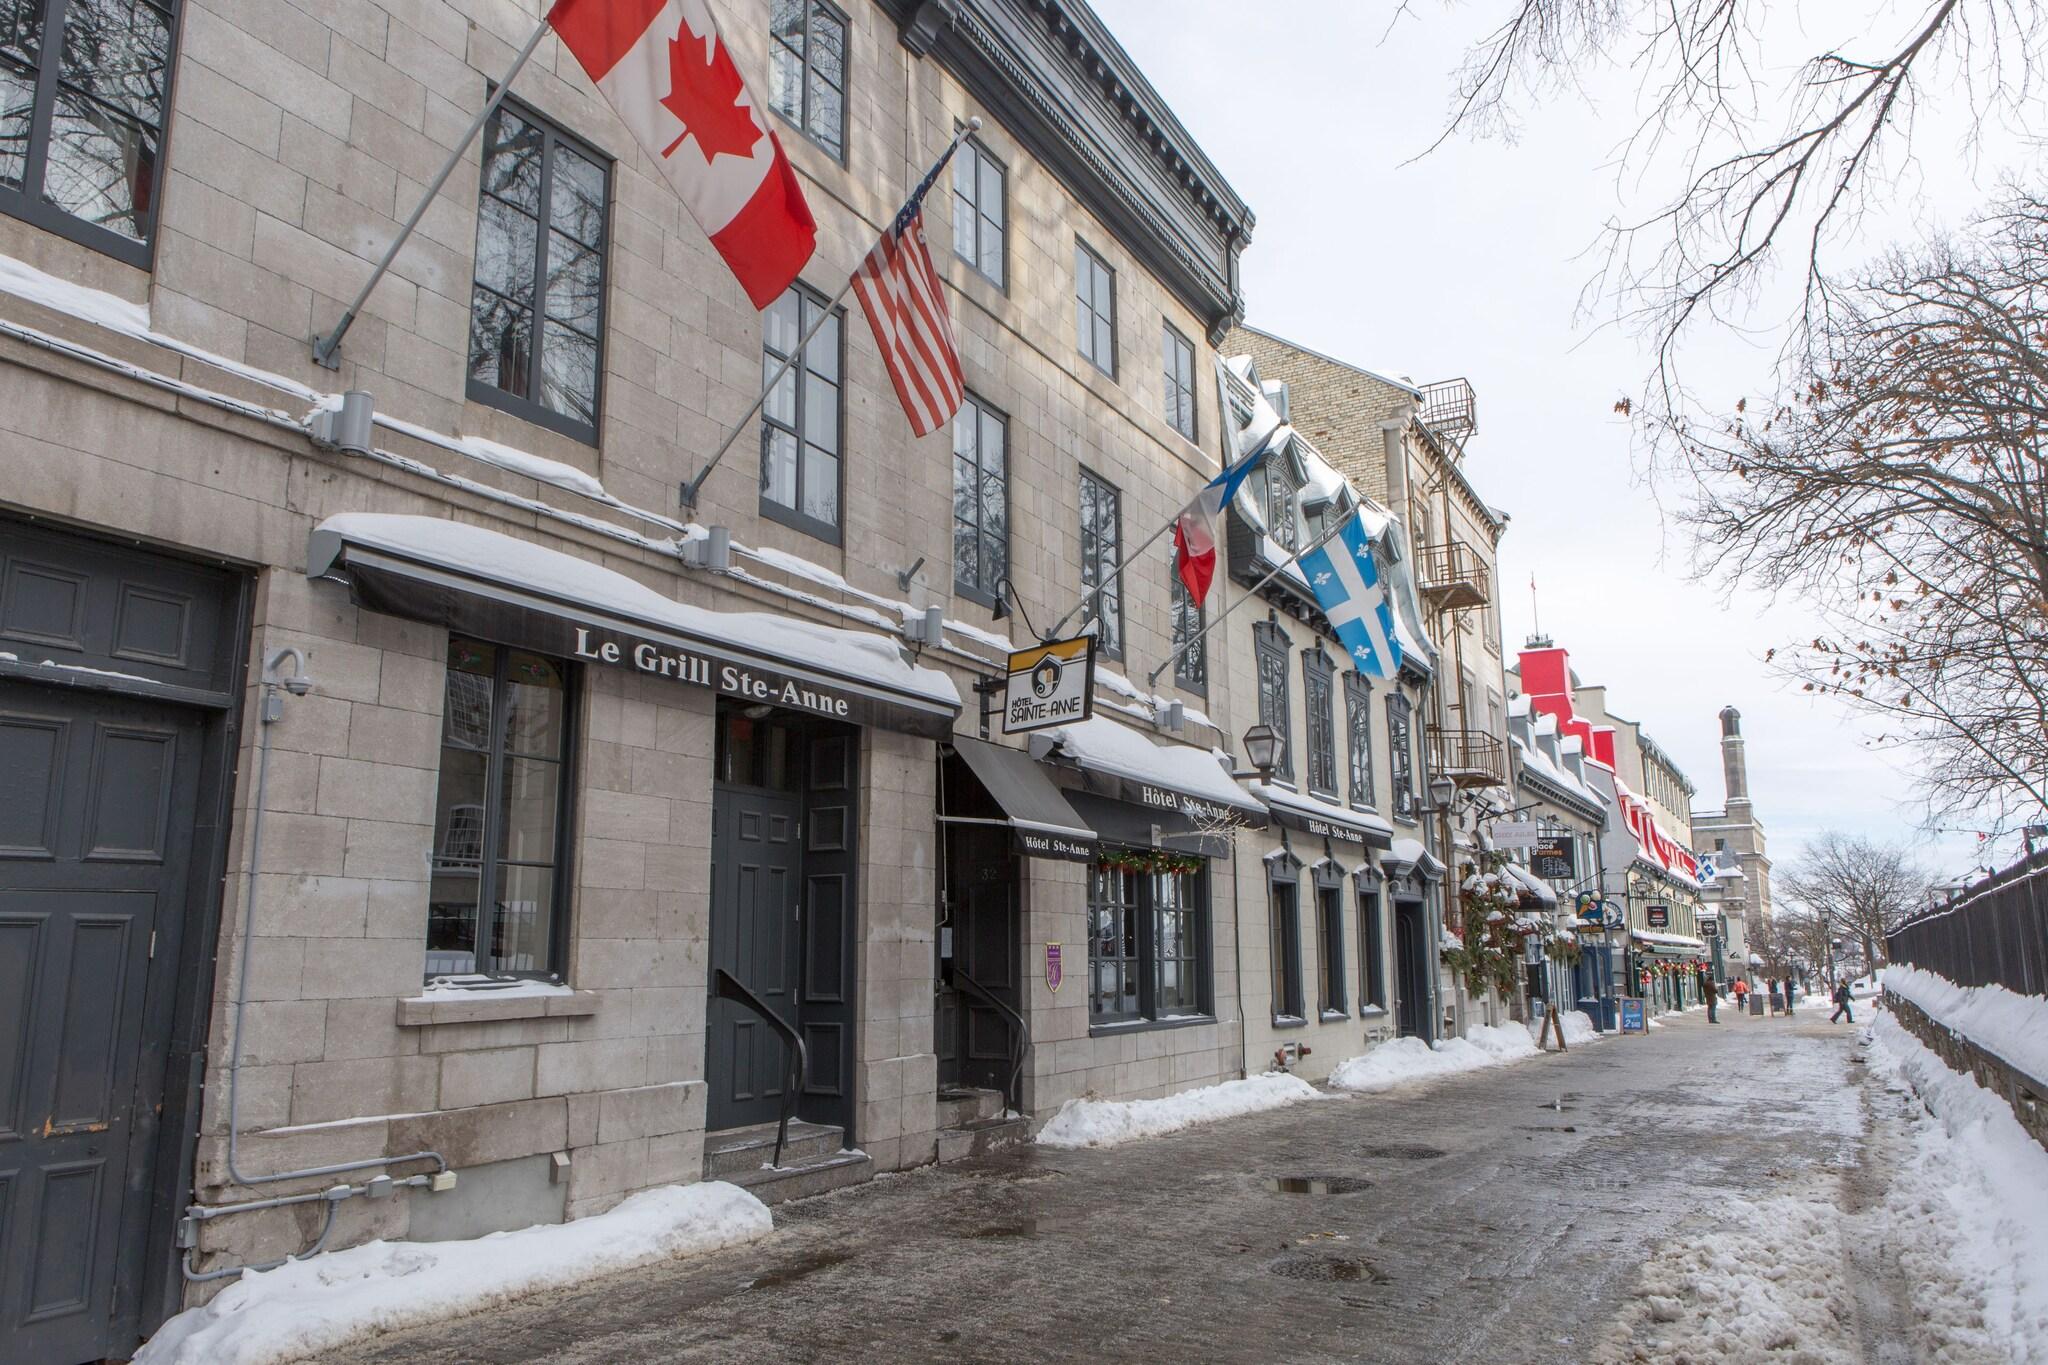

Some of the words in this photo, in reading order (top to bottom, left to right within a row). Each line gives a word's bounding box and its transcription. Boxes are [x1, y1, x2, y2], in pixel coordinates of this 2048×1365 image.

[575, 628, 620, 662] Le
[634, 643, 710, 686] Grill
[721, 666, 848, 717] Ste-Anne
[1011, 696, 1033, 708] HÔTEL
[1142, 785, 1178, 809] Hôtel
[1183, 796, 1231, 820] Ste-Anne
[1308, 820, 1330, 835] Hôtel
[1331, 825, 1364, 843] Ste-Anne
[1025, 836, 1050, 850] Hôtel
[1053, 839, 1090, 856] Ste-Anne
